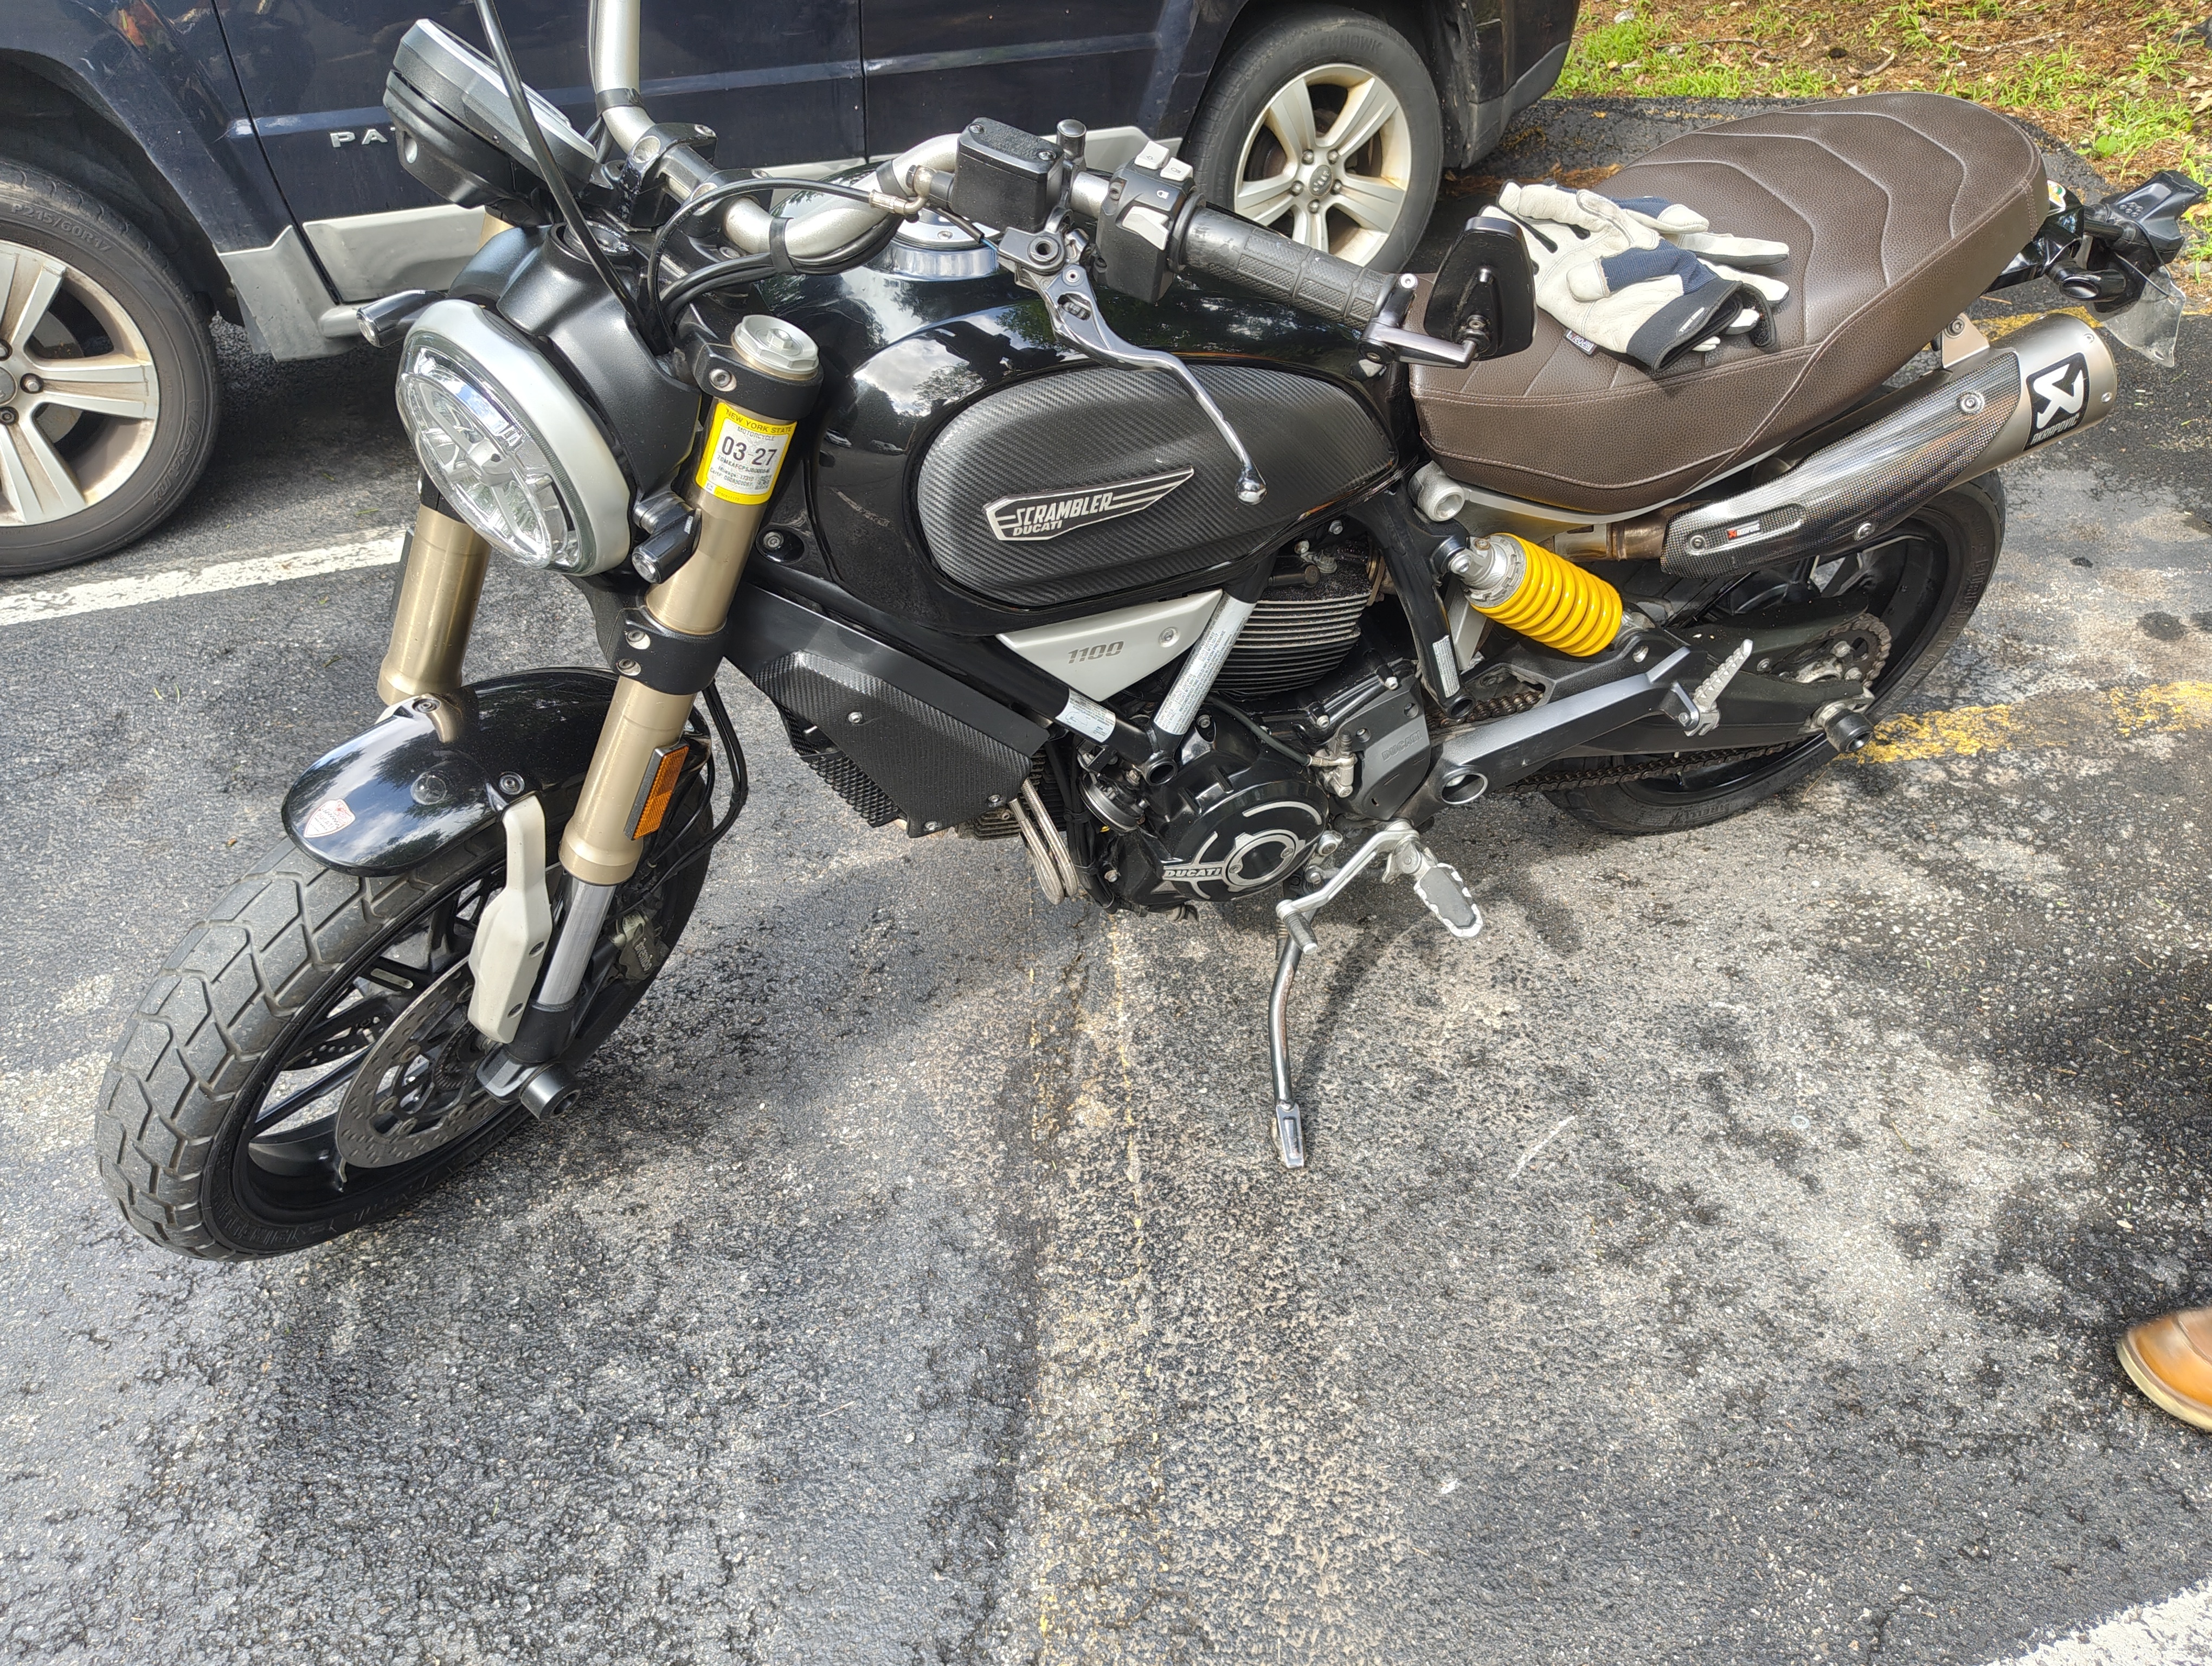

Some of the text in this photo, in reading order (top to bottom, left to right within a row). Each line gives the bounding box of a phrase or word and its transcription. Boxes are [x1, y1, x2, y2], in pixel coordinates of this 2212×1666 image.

[330, 127, 396, 148] PA
[10, 202, 112, 252] P215/60R17
[726, 408, 743, 422] NEW
[746, 420, 768, 432] YORK
[737, 426, 775, 441] MOTORCYCLE
[1012, 492, 1114, 527] SCRAMBLER
[1013, 520, 1063, 536] DUCATI
[1068, 640, 1124, 664] 1100
[1381, 730, 1422, 761] DUCATI
[1164, 868, 1221, 877] DUCATI
[634, 938, 652, 971] brembo
